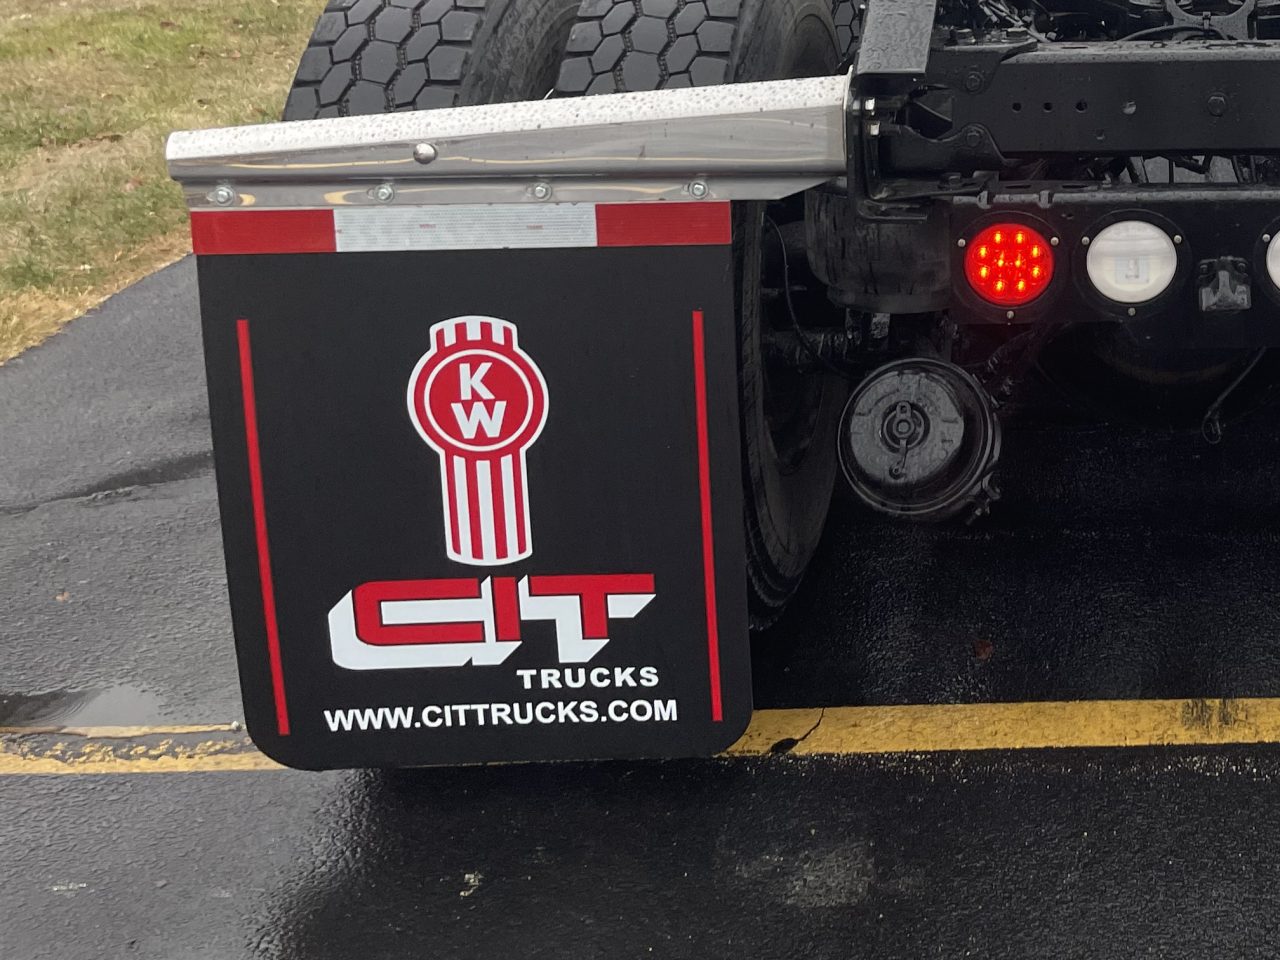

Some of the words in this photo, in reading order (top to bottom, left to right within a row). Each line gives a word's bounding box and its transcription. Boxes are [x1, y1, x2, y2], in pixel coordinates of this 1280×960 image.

[459, 362, 496, 400] K
[450, 401, 508, 440] W
[327, 573, 658, 671] CIT
[516, 666, 660, 690] TRUCKS
[323, 699, 679, 732] WWW.CITTRUCKS.COM
